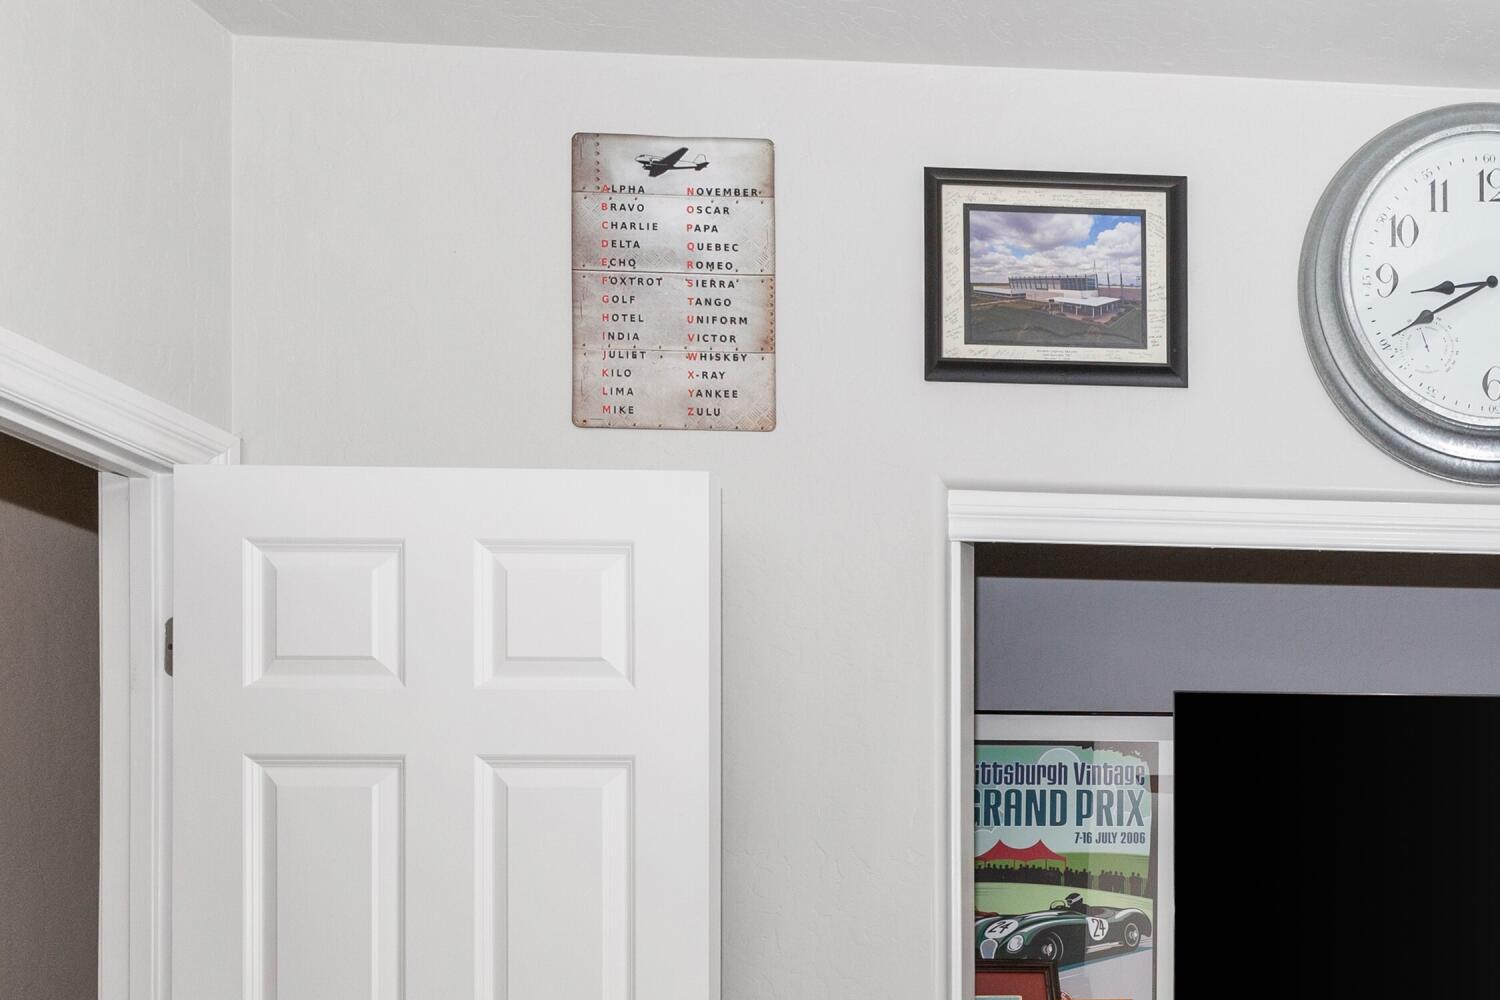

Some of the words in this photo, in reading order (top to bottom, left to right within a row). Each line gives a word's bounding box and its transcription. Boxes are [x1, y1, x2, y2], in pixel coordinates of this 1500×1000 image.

[1483, 154, 1496, 163] 60
[602, 184, 645, 194] ALPHA
[687, 187, 758, 197] NOVEMBER
[1428, 179, 1448, 213] 11
[601, 202, 645, 212] BRAVO
[686, 205, 730, 215] OSCAR
[601, 221, 658, 231] CHARLIE
[686, 223, 719, 233] PAPA
[1388, 213, 1419, 248] 10
[601, 239, 641, 249] DELTA
[687, 242, 740, 252] QUEBEC
[601, 258, 636, 267] ECHO
[687, 260, 733, 270] ROMEO
[602, 276, 663, 286] FOXTROT
[687, 279, 735, 289] SIERRA
[1375, 262, 1399, 298] 9
[602, 295, 636, 304] GOLF
[687, 297, 732, 307] TANGO
[602, 313, 644, 323] HOTEL
[687, 315, 748, 325] UNIFORM
[602, 331, 640, 341] INDIA
[687, 333, 737, 343] VICTOR
[602, 350, 646, 360] JULIET
[687, 352, 748, 362] WHISKEY
[602, 368, 632, 378] KILO
[687, 370, 726, 380] X-RAY
[602, 387, 634, 396] LIMA
[688, 389, 738, 399] YANKEE
[602, 405, 635, 415] MIKE
[687, 407, 721, 417] ZULU
[974, 762, 1068, 785] ittsburgh
[1073, 762, 1145, 785] Vintage
[1076, 789, 1145, 827] PRIX
[1074, 831, 1093, 844] 7-16
[1095, 831, 1118, 844] JULY
[1120, 831, 1146, 844] 2006
[986, 920, 1014, 934] 24
[1091, 918, 1106, 937] 24
